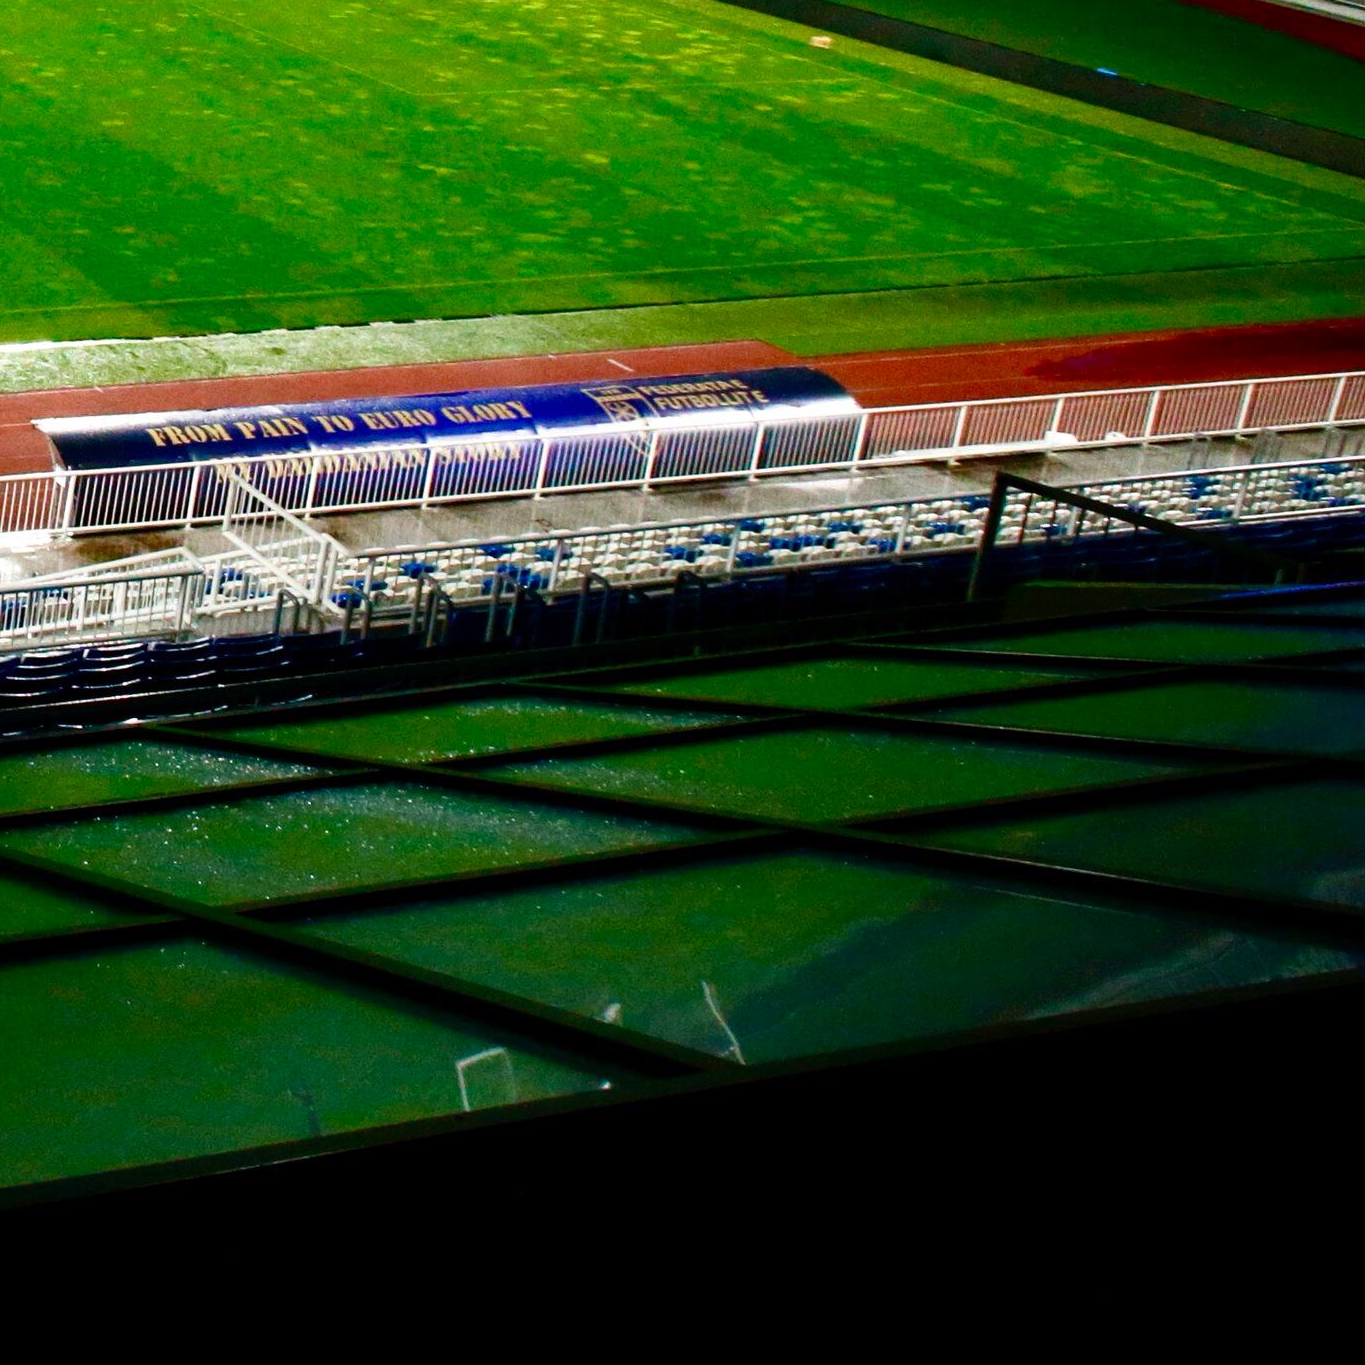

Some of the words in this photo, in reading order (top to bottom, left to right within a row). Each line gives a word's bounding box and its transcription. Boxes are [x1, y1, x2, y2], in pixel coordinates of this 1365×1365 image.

[638, 381, 731, 395] FEDERATA
[729, 379, 749, 389] E
[654, 392, 753, 410] FUTBOLLIT
[751, 390, 769, 403] E
[146, 423, 232, 447] FROM
[234, 417, 309, 439] PAIN
[312, 415, 355, 433] TO
[359, 408, 437, 430] EURO
[441, 401, 532, 424] GLORY
